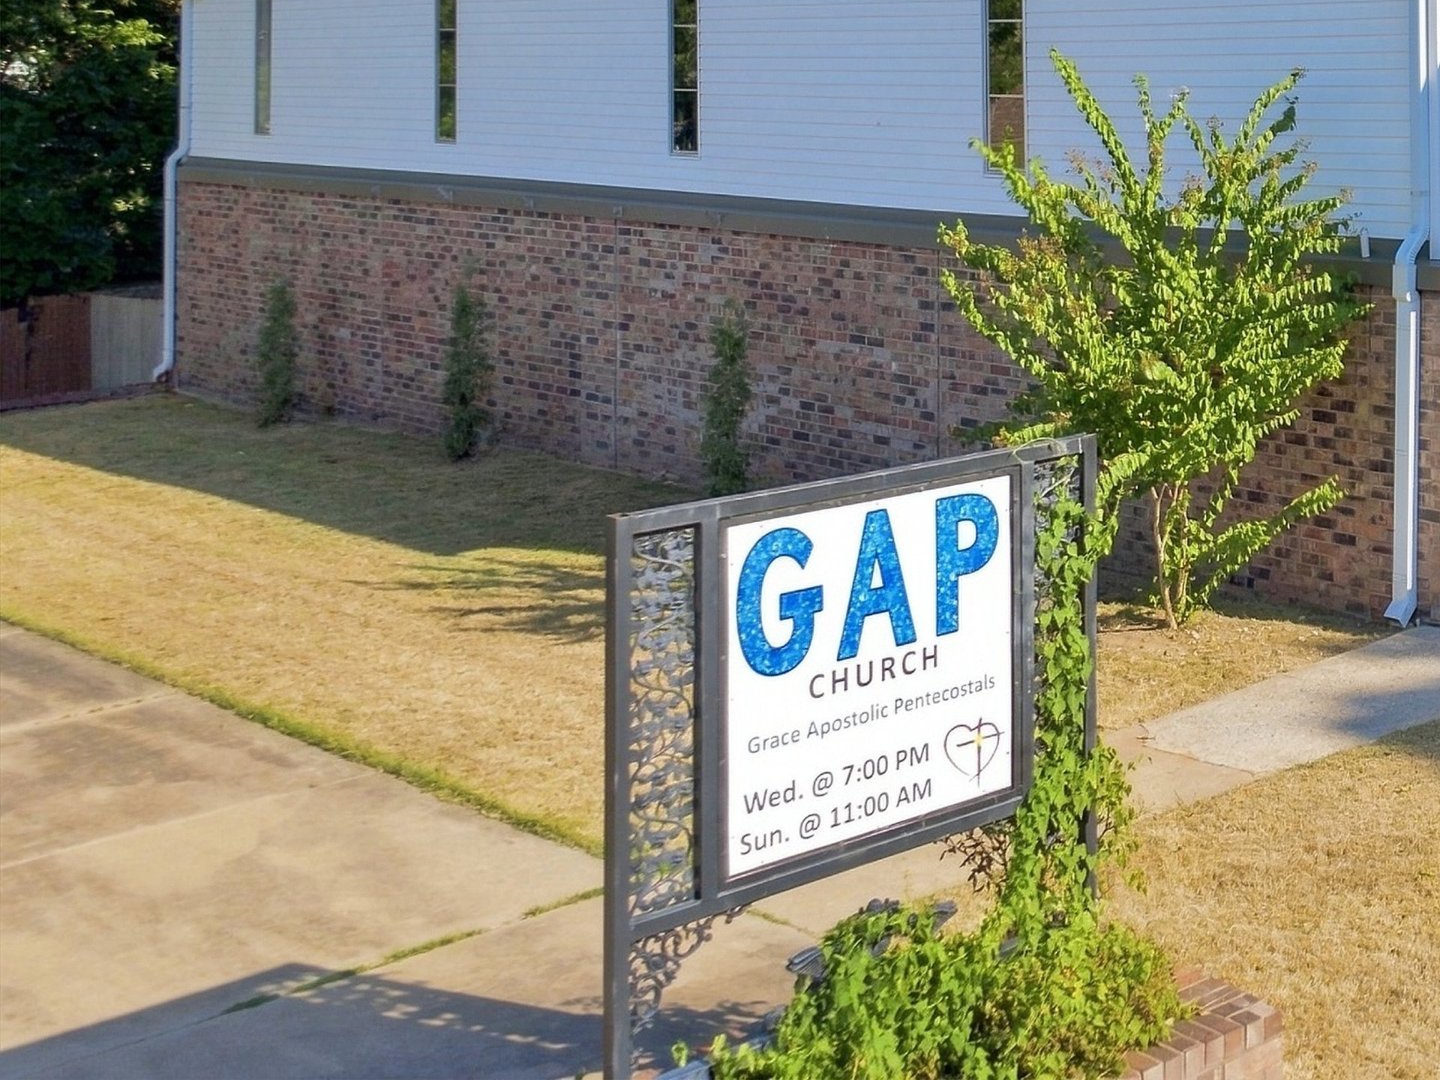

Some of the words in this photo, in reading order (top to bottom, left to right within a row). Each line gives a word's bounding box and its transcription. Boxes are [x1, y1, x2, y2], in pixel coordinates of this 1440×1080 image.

[736, 493, 1000, 677] GAP
[809, 644, 939, 699] CHURCH
[748, 728, 801, 754] Grace
[806, 704, 889, 740] Apostolic
[894, 674, 996, 715] Pentecostals
[740, 828, 790, 855] Sun.
[799, 813, 821, 840] @
[829, 792, 889, 828] 11:00
[896, 778, 932, 807] AM
[743, 780, 804, 815] Wed.
[812, 771, 834, 797] @
[842, 755, 889, 786] 7:00
[895, 743, 930, 771] PM
